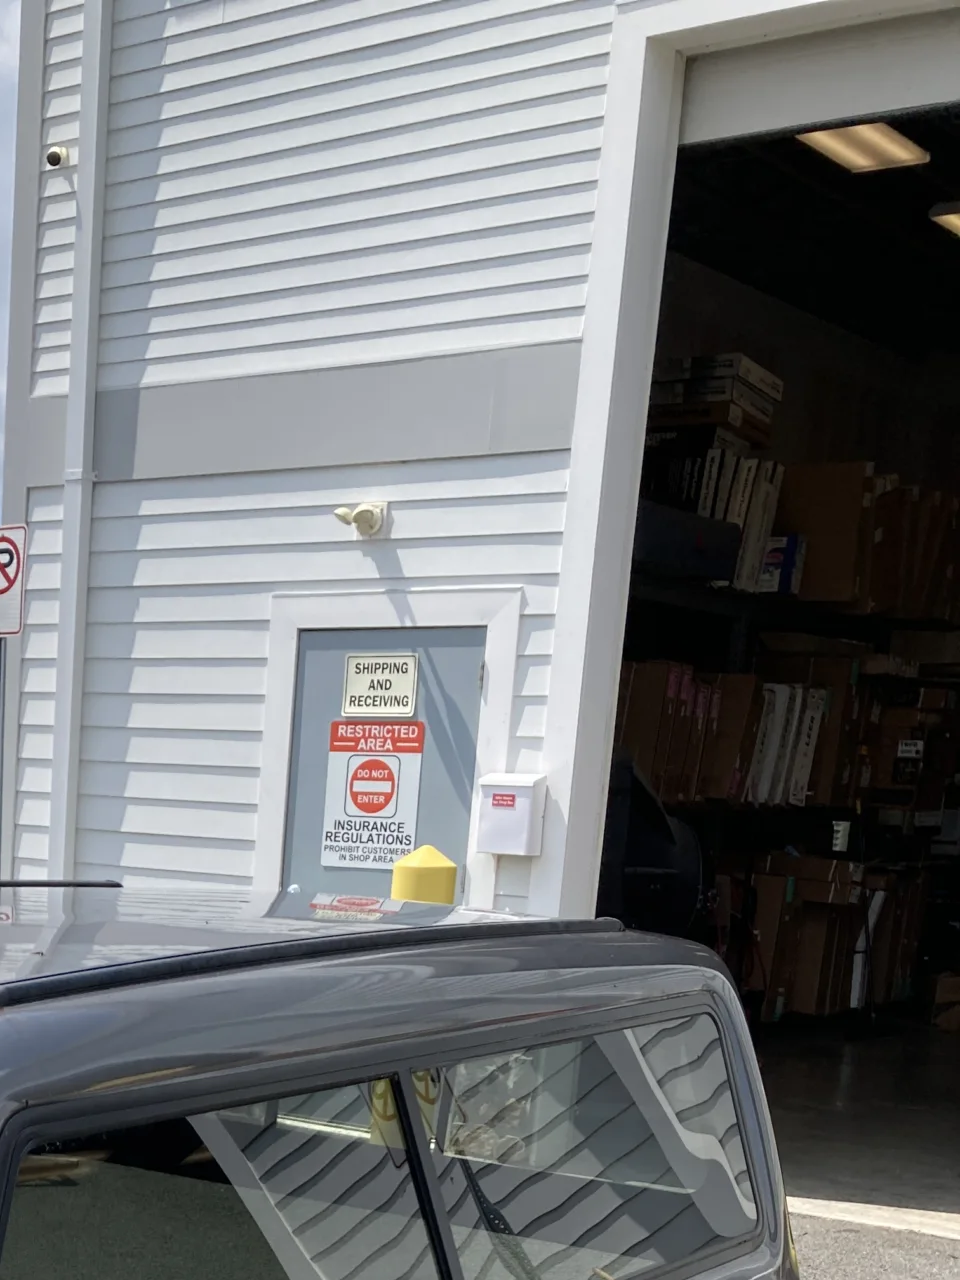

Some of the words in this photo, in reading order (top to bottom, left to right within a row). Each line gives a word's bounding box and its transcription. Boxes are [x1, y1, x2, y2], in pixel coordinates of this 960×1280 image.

[354, 662, 409, 675] SHIPPING
[368, 679, 392, 691] AND
[349, 695, 409, 707] RECEIVING
[338, 725, 418, 738] RESTRICTED
[357, 738, 393, 751] AREA
[357, 769, 370, 778] DO
[371, 769, 389, 778] NOT
[357, 795, 385, 804] ENTER
[334, 819, 405, 833] INSURANCE
[325, 831, 412, 846] REGULATIONS
[324, 844, 360, 854] PROHIBIT
[361, 846, 411, 856] CUSTOMERS
[338, 853, 347, 861] IN
[348, 854, 370, 862] SHOP
[371, 855, 394, 863] AREA
